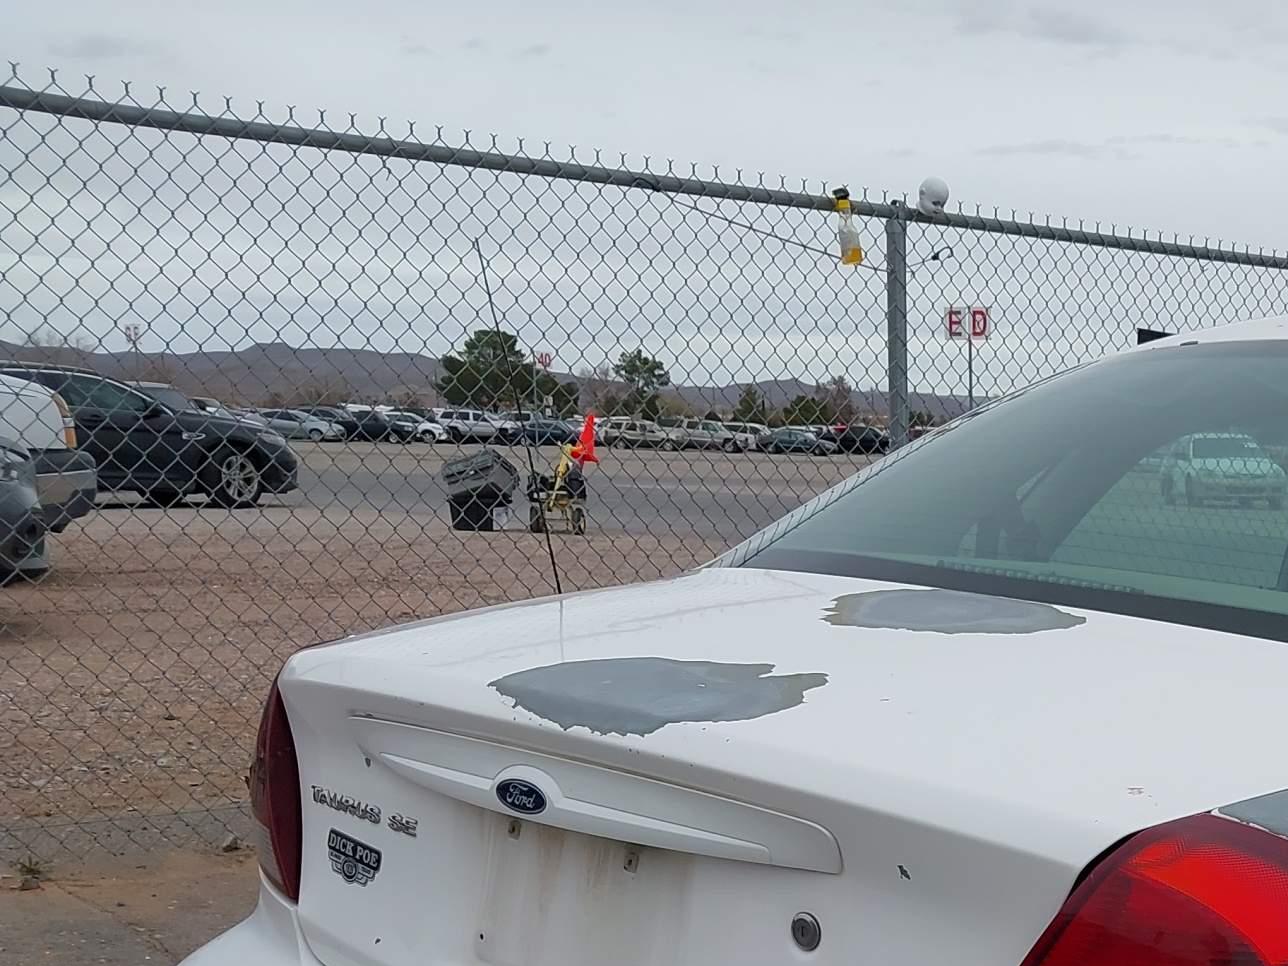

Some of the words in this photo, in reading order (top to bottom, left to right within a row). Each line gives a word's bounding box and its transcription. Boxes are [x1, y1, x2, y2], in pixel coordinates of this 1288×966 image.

[311, 784, 381, 824] TAURUS
[387, 813, 418, 838] SE
[506, 782, 536, 809] Ford
[328, 832, 354, 857] DICK
[355, 845, 379, 868] POE
